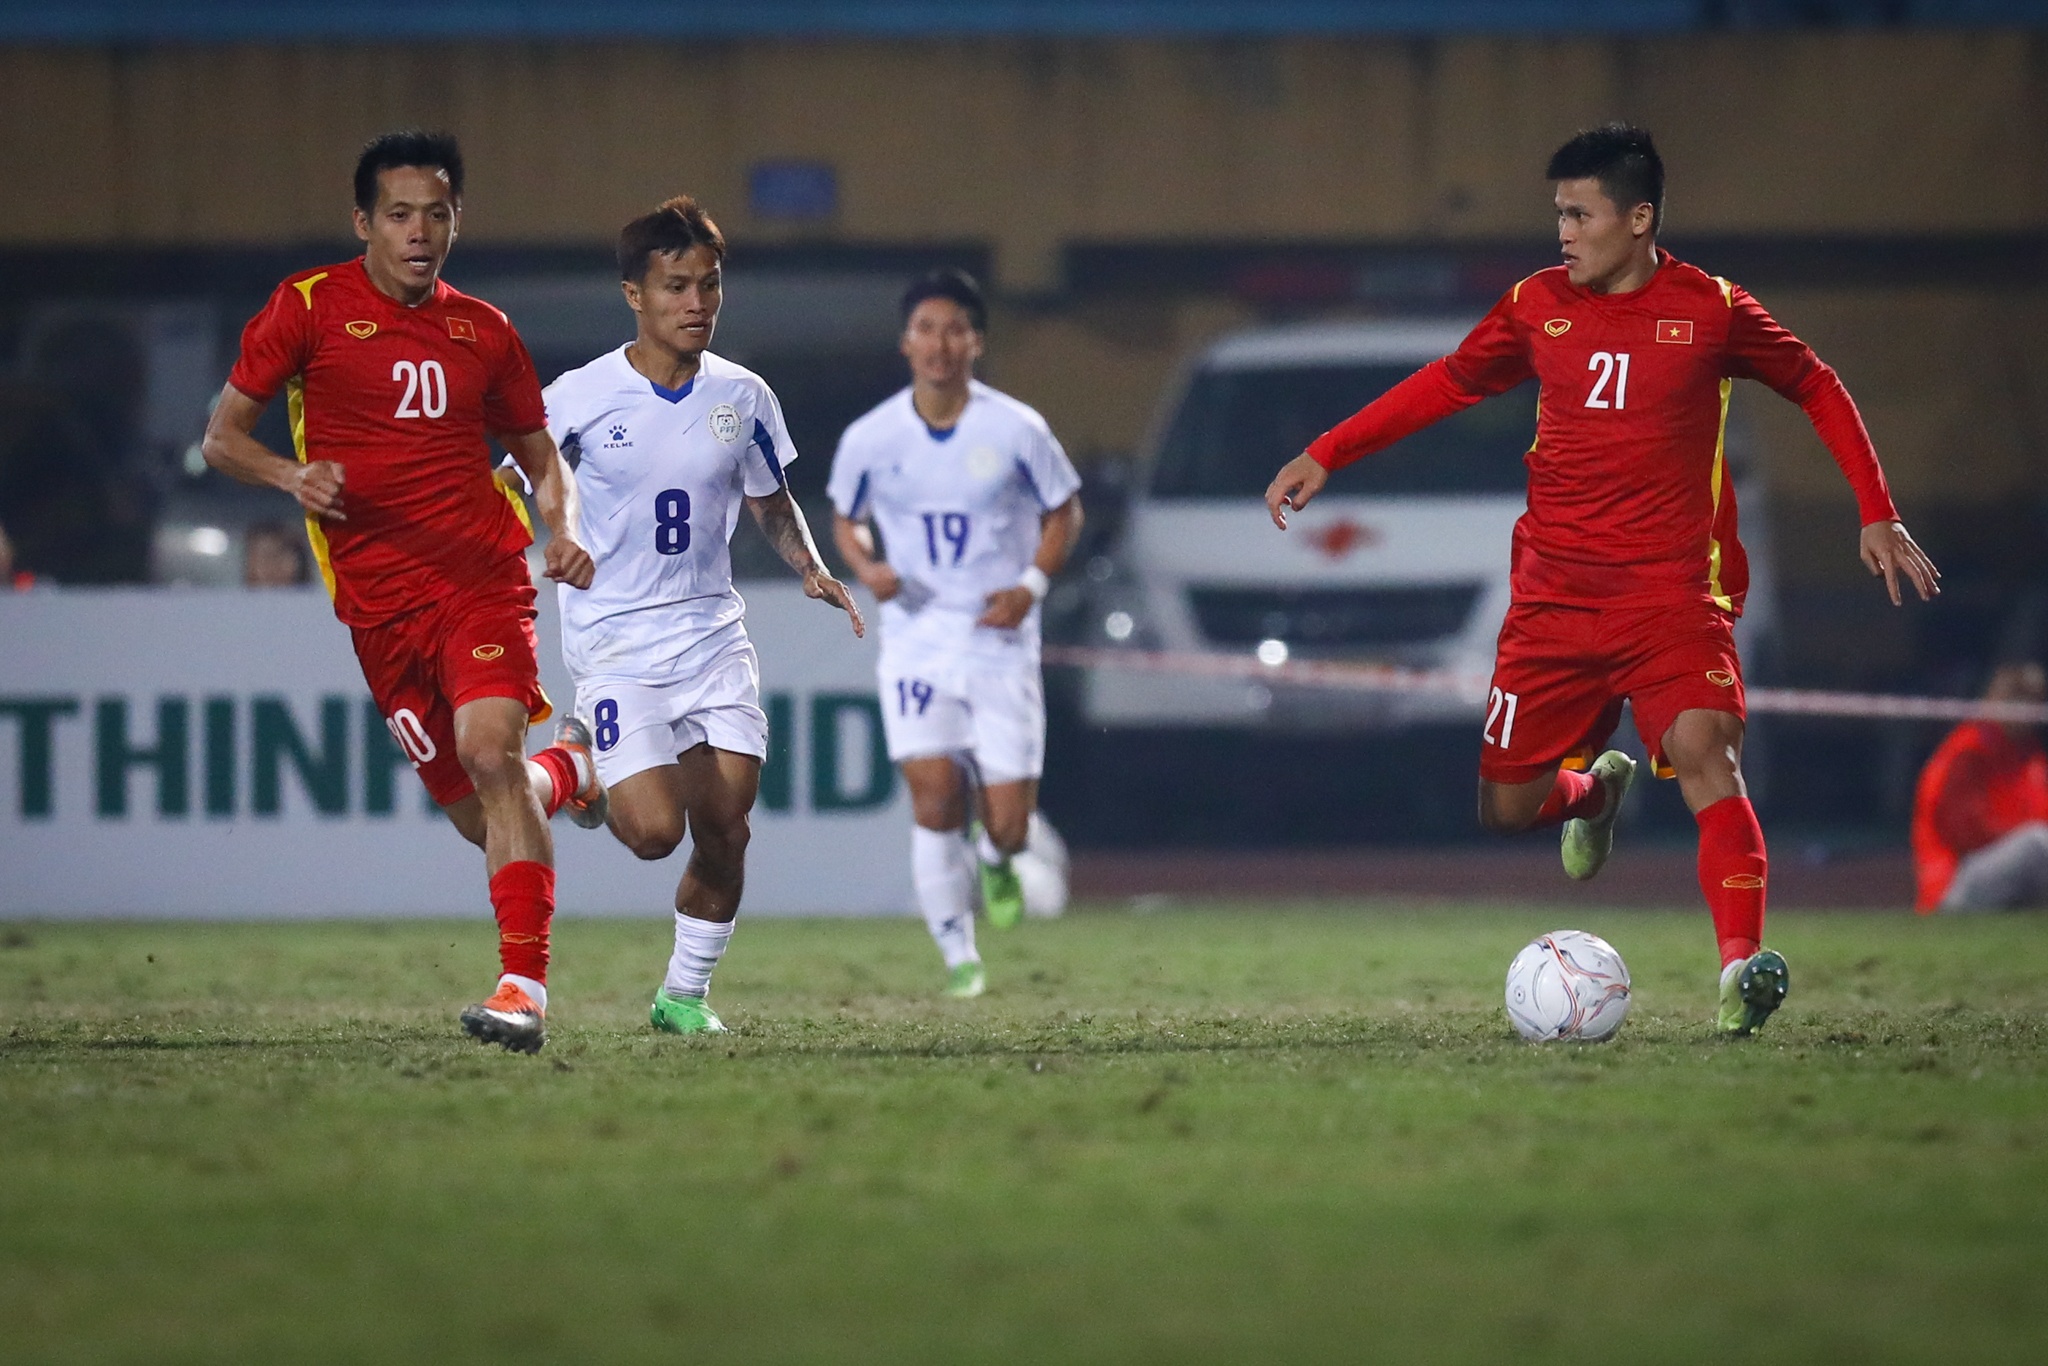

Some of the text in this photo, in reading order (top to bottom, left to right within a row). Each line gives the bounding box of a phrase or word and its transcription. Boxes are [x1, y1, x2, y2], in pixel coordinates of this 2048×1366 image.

[392, 360, 447, 418] 20
[1584, 351, 1630, 409] 21
[603, 441, 634, 449] KELME
[655, 489, 691, 555] 8
[922, 511, 970, 567] 19
[594, 698, 620, 752] 8
[897, 677, 934, 717] 19
[1483, 686, 1518, 749] 21
